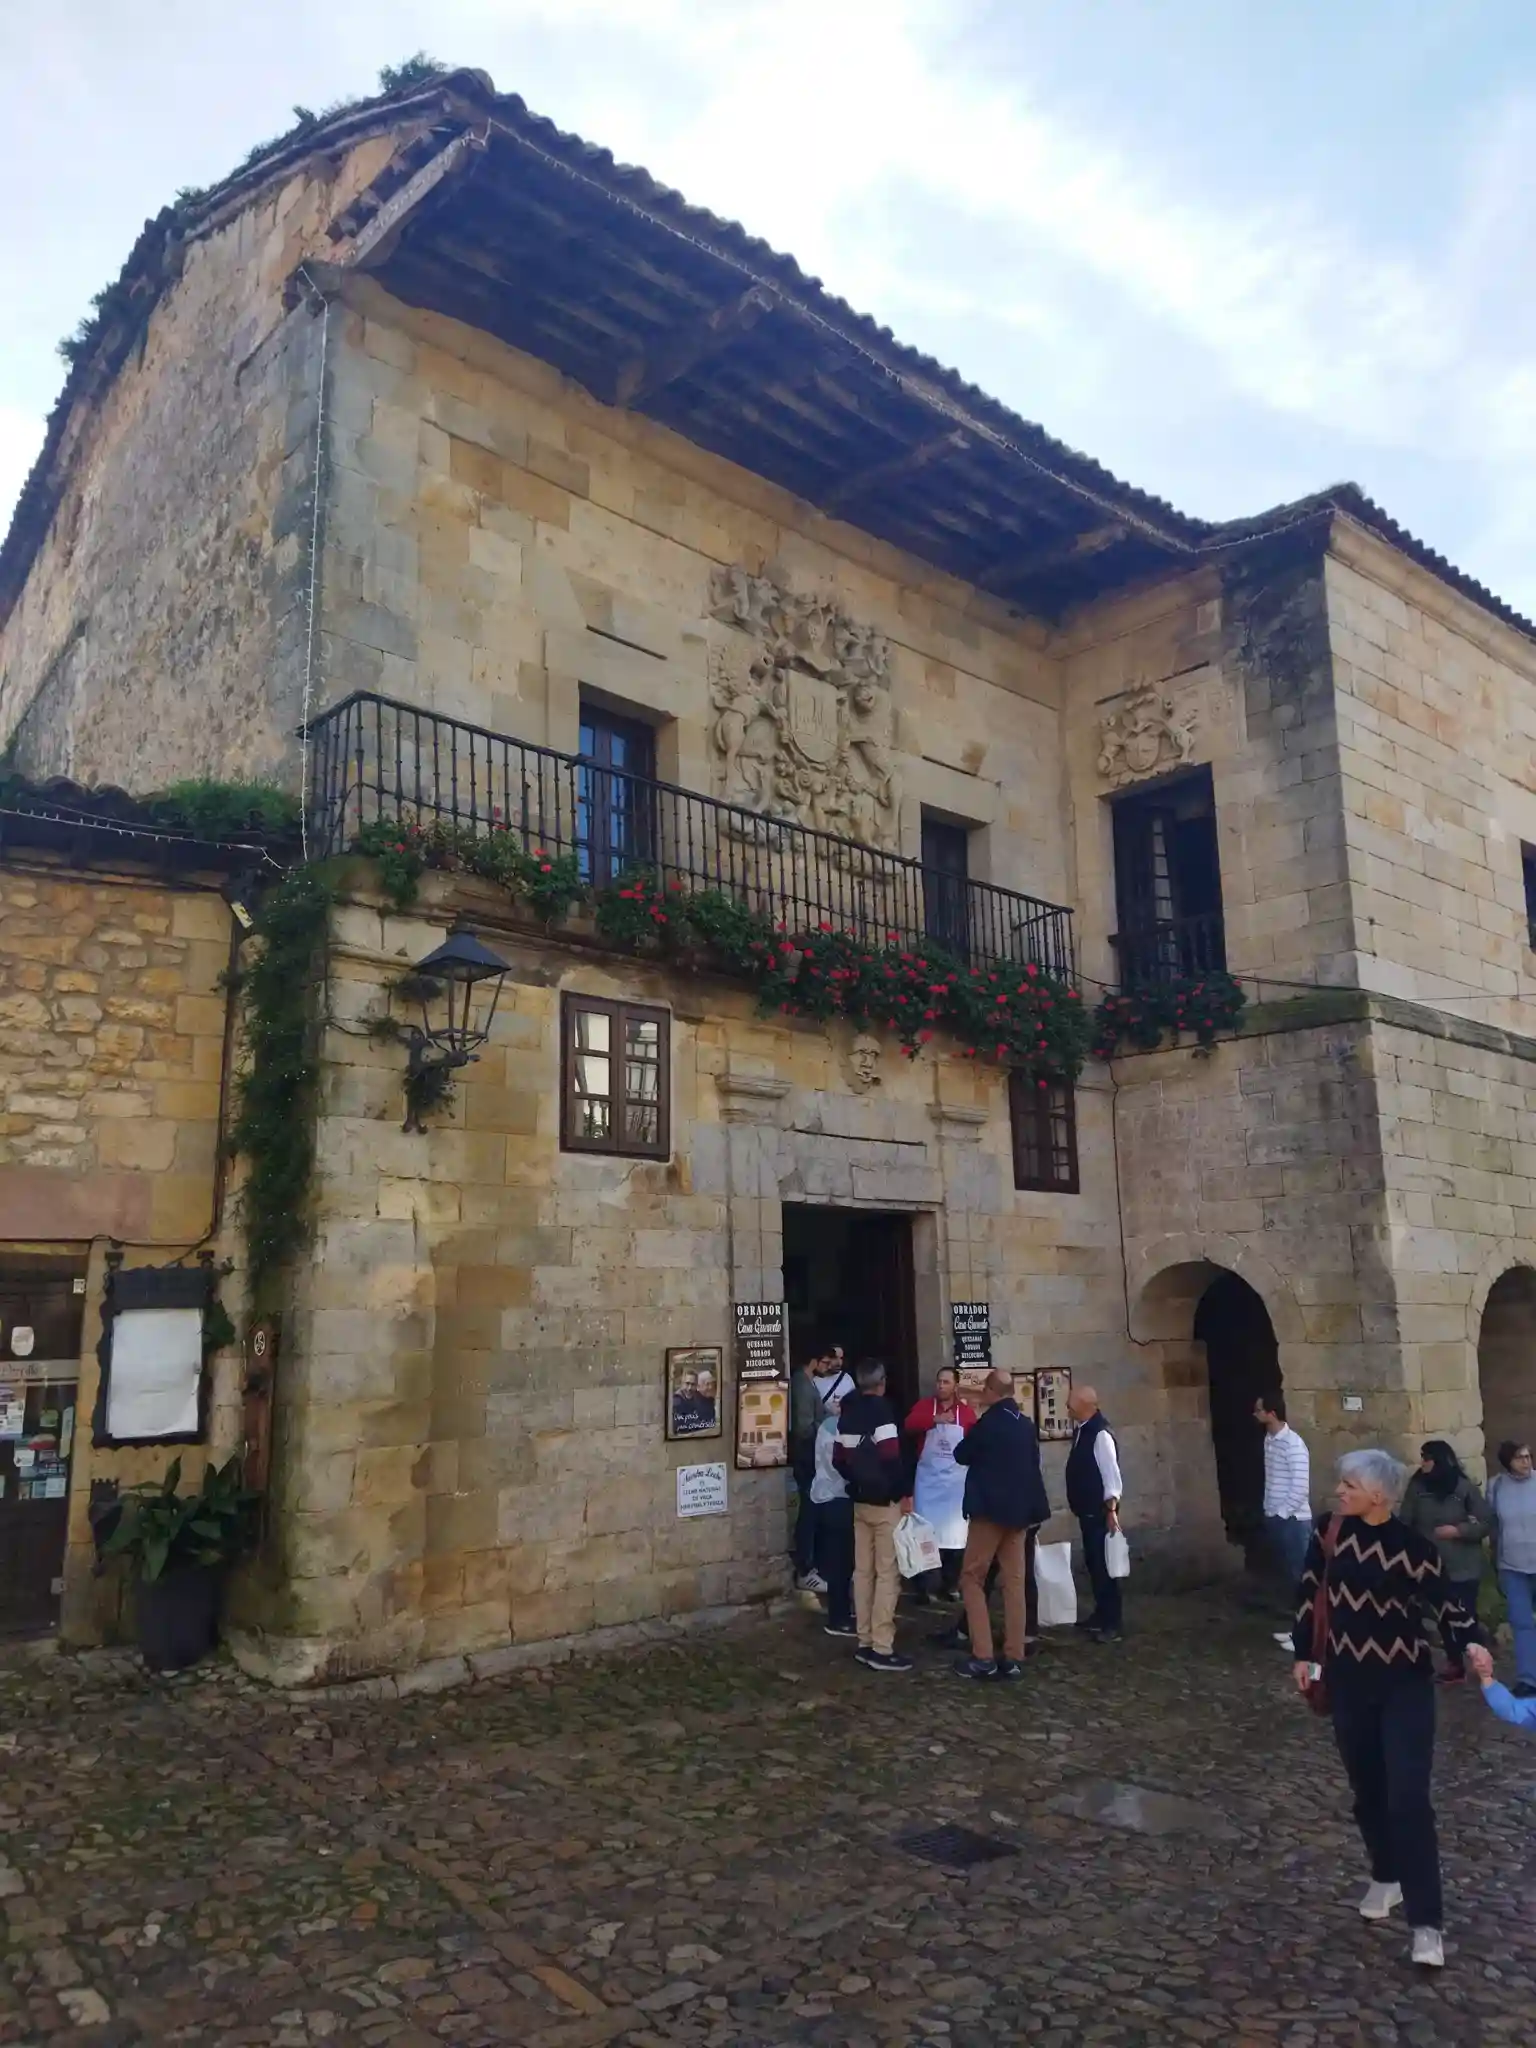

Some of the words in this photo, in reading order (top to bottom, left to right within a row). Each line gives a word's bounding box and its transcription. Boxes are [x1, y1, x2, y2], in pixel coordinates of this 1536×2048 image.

[737, 1305, 781, 1315] OBRADOR
[953, 1305, 987, 1314] OBRADOR
[737, 1317, 753, 1334] Casa
[754, 1316, 782, 1334] Quevedo
[954, 1315, 967, 1330] Casa
[746, 1340, 774, 1348] QUESADAS
[750, 1350, 771, 1358] SOBAOS
[745, 1359, 776, 1368] BIZCOCHOS
